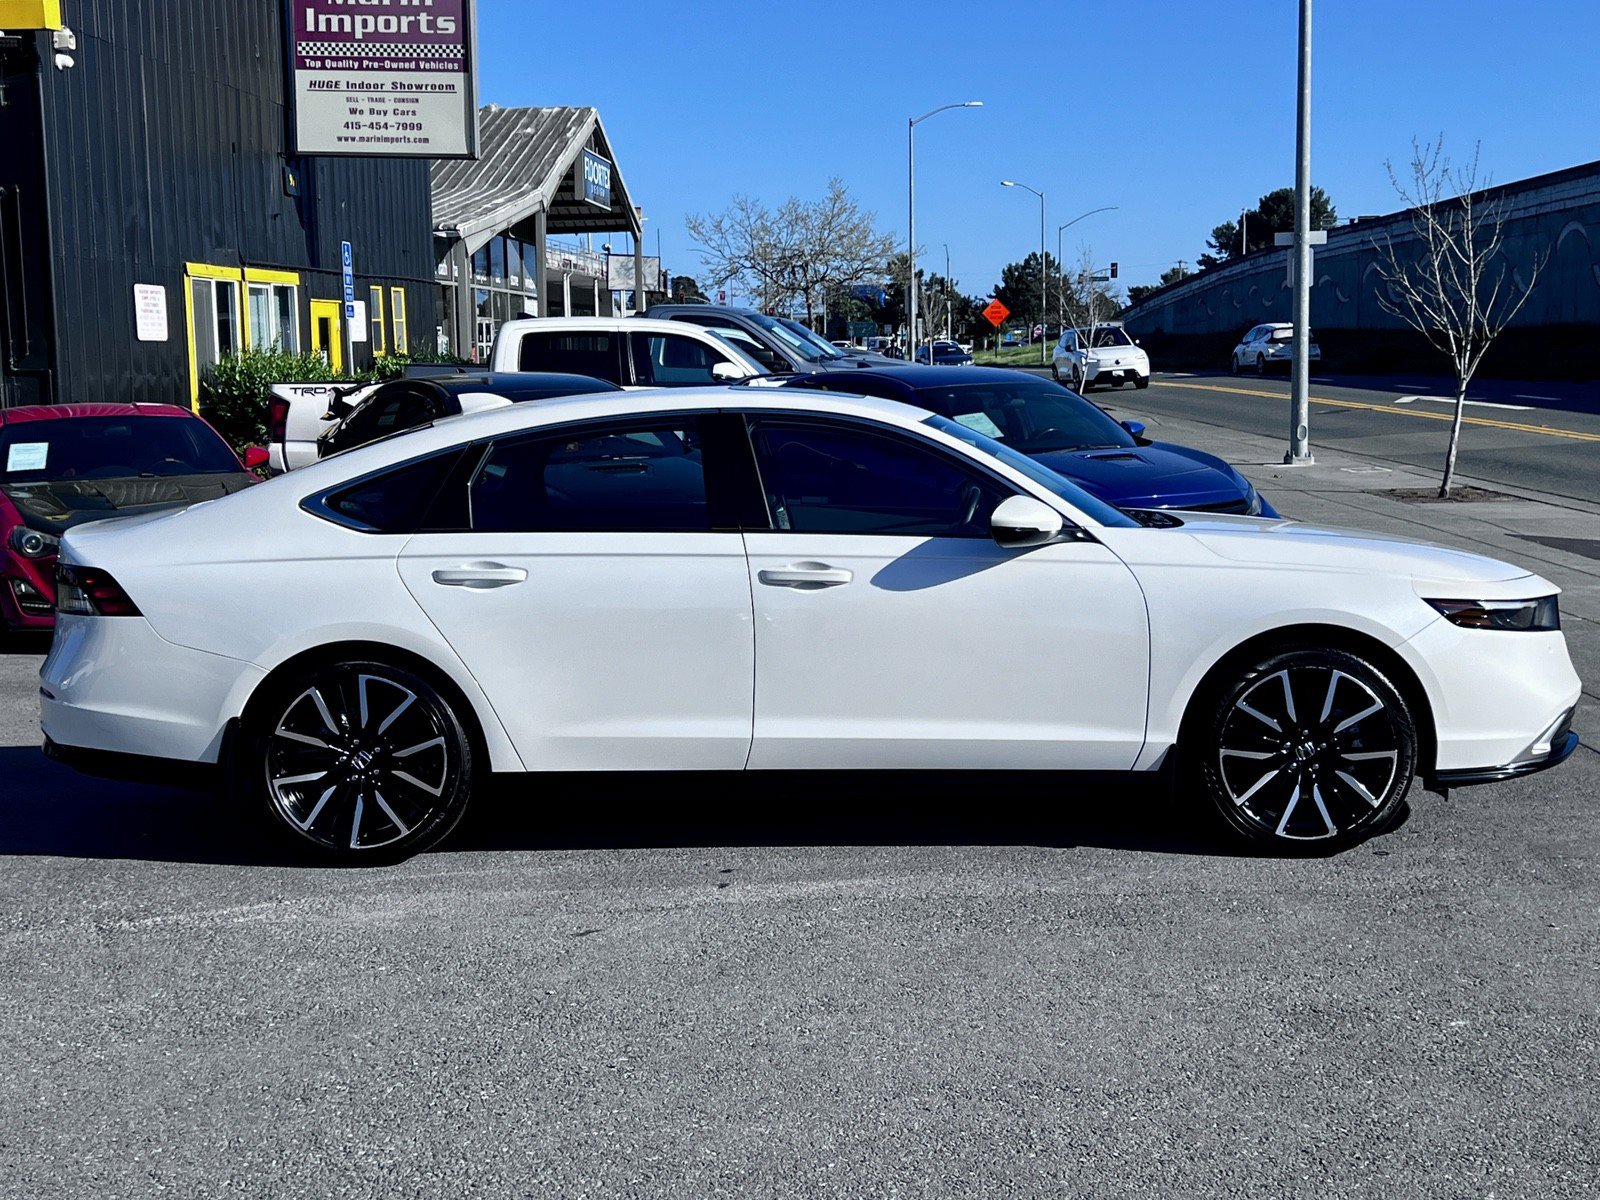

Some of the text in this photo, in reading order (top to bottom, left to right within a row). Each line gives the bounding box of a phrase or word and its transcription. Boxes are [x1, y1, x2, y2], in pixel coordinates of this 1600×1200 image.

[306, 8, 456, 39] Imports
[304, 58, 459, 70] Top Quality Pre-Owned Vehicles
[309, 80, 455, 91] HUGE Indoor Showroom
[369, 108, 388, 116] Buy
[393, 108, 417, 116] Cars
[343, 121, 422, 131] 415-454-7999
[336, 135, 430, 144] www.marinimports.com
[289, 387, 327, 396] TRD
